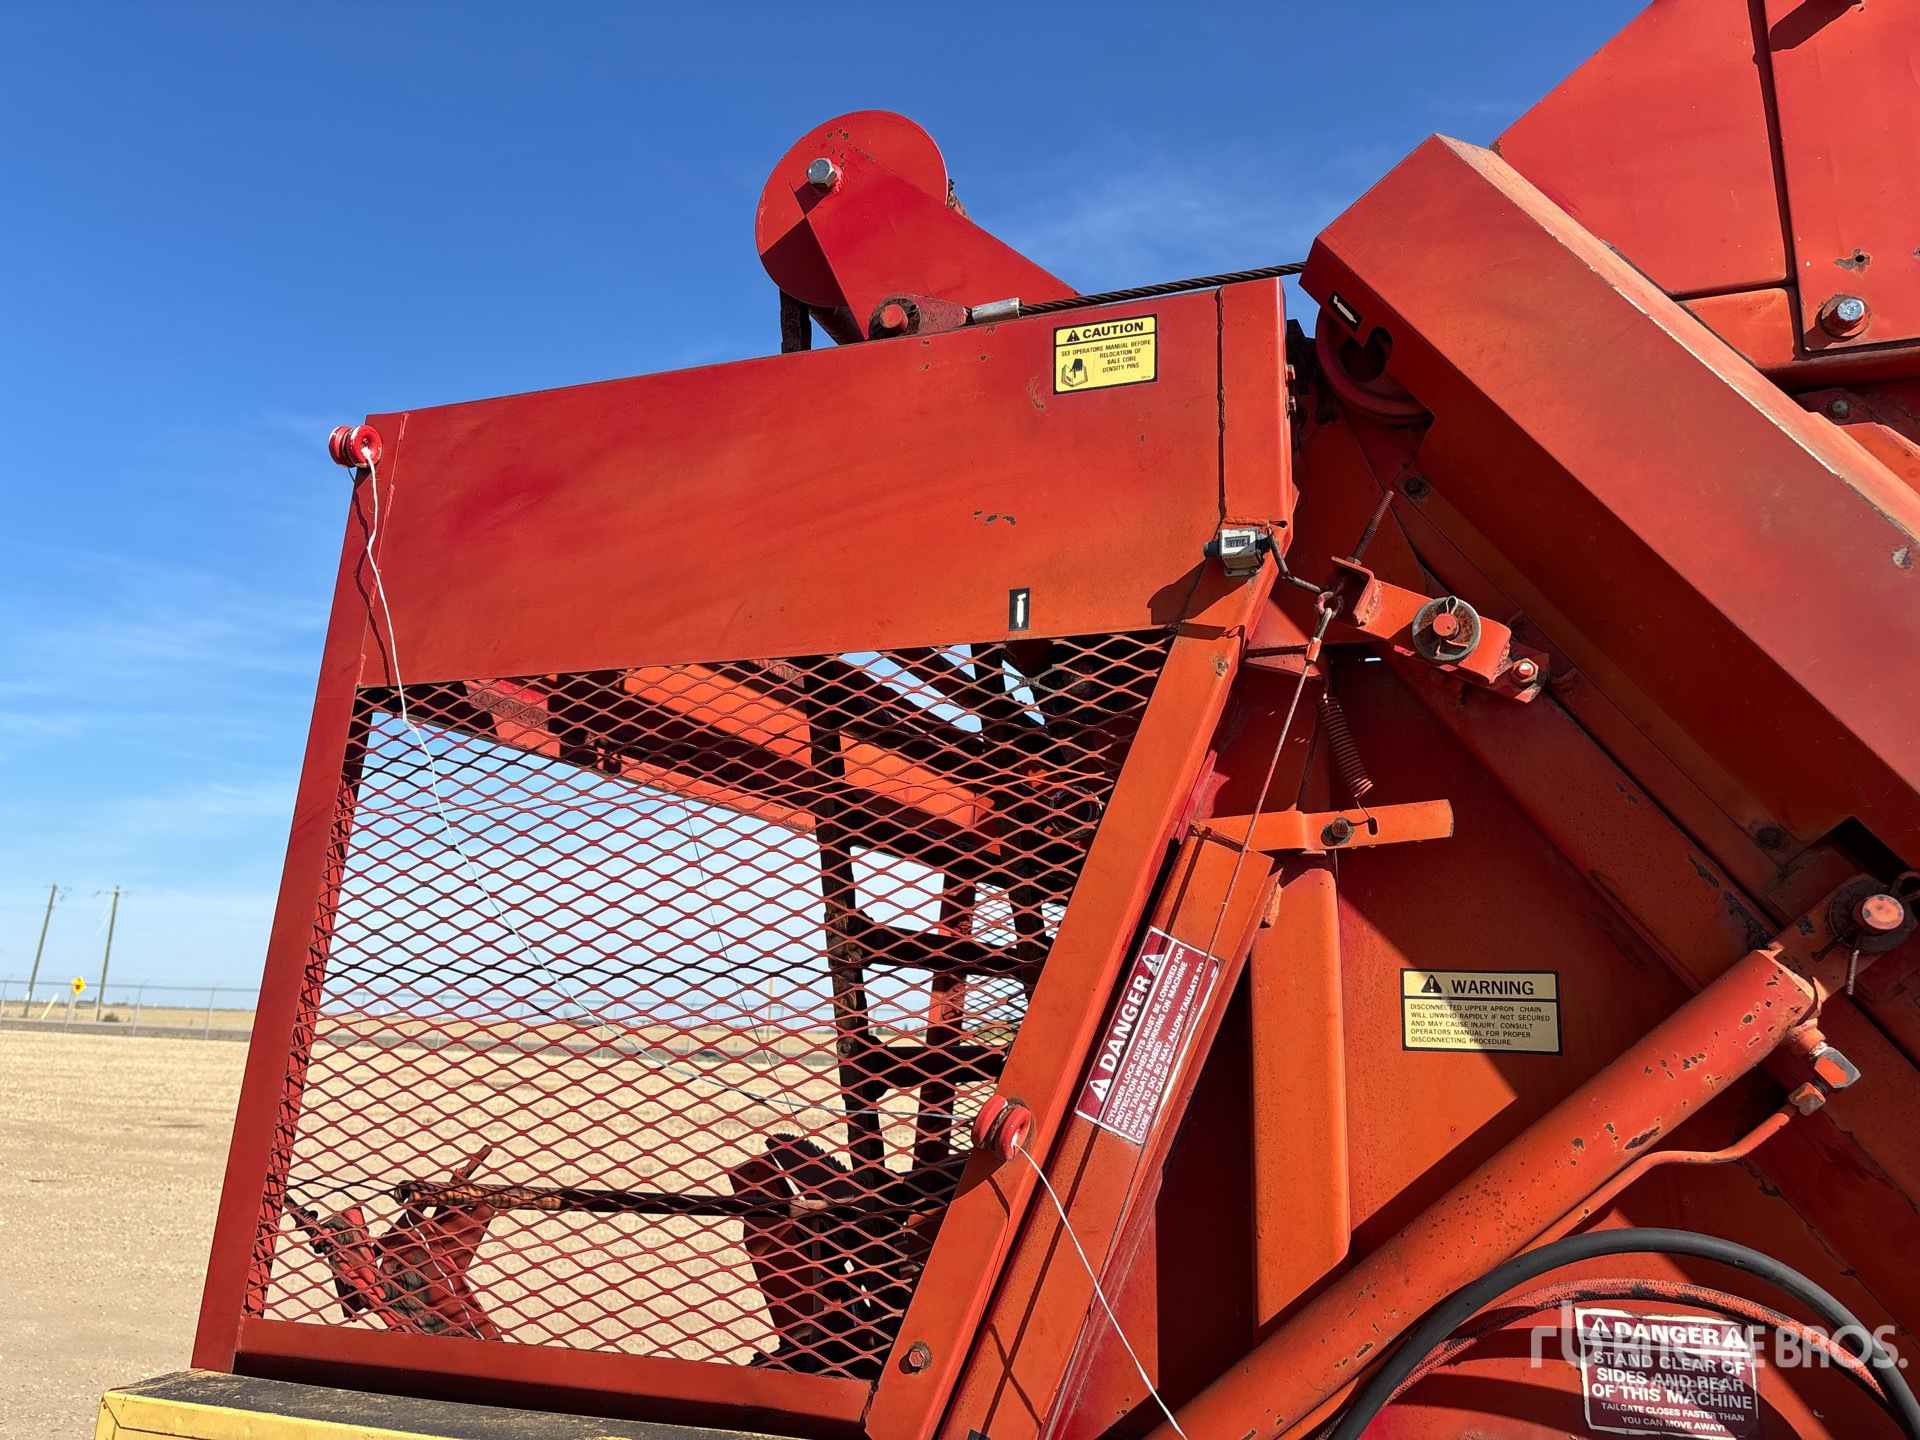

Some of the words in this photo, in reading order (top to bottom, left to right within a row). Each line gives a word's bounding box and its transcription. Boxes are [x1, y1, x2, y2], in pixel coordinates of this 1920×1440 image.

[1082, 322, 1144, 338] CAUTION
[1072, 346, 1104, 356] OPERATORS
[1130, 339, 1151, 347] BEFORE
[1100, 349, 1132, 358] RELOCATION
[1102, 365, 1124, 373] DENSITY
[1451, 980, 1534, 995] WARNING
[1100, 976, 1150, 1071] DANGER
[1106, 1085, 1126, 1123] CYLINDER
[1122, 1062, 1136, 1084] LOCK
[1132, 1039, 1146, 1061] OUTS
[1142, 1014, 1156, 1038] MUST
[1152, 1002, 1161, 1014] BE
[1157, 964, 1177, 1001] LOWERED
[1173, 947, 1184, 963] FOR
[1500, 1022, 1533, 1030] CONSULT
[1113, 1078, 1138, 1127] PROTECTION
[1134, 1052, 1149, 1076] WHEN
[1144, 1013, 1165, 1051] WORKING
[1161, 999, 1171, 1012] ON
[1167, 961, 1187, 998] MACHINE
[1128, 1102, 1146, 1135] FAILURE
[1141, 1089, 1151, 1101] TO
[1147, 1076, 1157, 1089] DO
[1153, 1062, 1162, 1075] SO
[1158, 1042, 1170, 1062] MAY
[1168, 1012, 1183, 1042] ALLOW
[1179, 974, 1198, 1011] TAILGATE
[1196, 962, 1203, 972] TO
[1120, 1109, 1133, 1130] WITH
[1129, 1071, 1150, 1108] TAILGATE
[1146, 1040, 1163, 1070] RAISED.
[1135, 1113, 1150, 1139] CLOSE
[1146, 1094, 1158, 1113] AND
[1154, 1065, 1168, 1093] CAUSE
[1614, 1322, 1720, 1346] DANGER
[1593, 1352, 1654, 1368] STAND
[1659, 1356, 1716, 1372] CLEAR
[1722, 1360, 1746, 1375] OF
[1596, 1368, 1648, 1384] SIDES
[1652, 1373, 1690, 1388] AND
[1697, 1376, 1744, 1392] REAR
[1591, 1384, 1615, 1398] OF
[1619, 1386, 1660, 1401] THIS
[1666, 1390, 1752, 1410] MACHINE
[1601, 1402, 1644, 1413] TAILGATE
[1645, 1406, 1680, 1416] CLOSES
[1682, 1409, 1716, 1420] FASTER
[1718, 1412, 1744, 1422] THAN
[1622, 1416, 1640, 1425] YOU
[1643, 1417, 1663, 1426] CAN
[1665, 1420, 1692, 1429] MOVE
[1694, 1422, 1725, 1432] AWAY!
